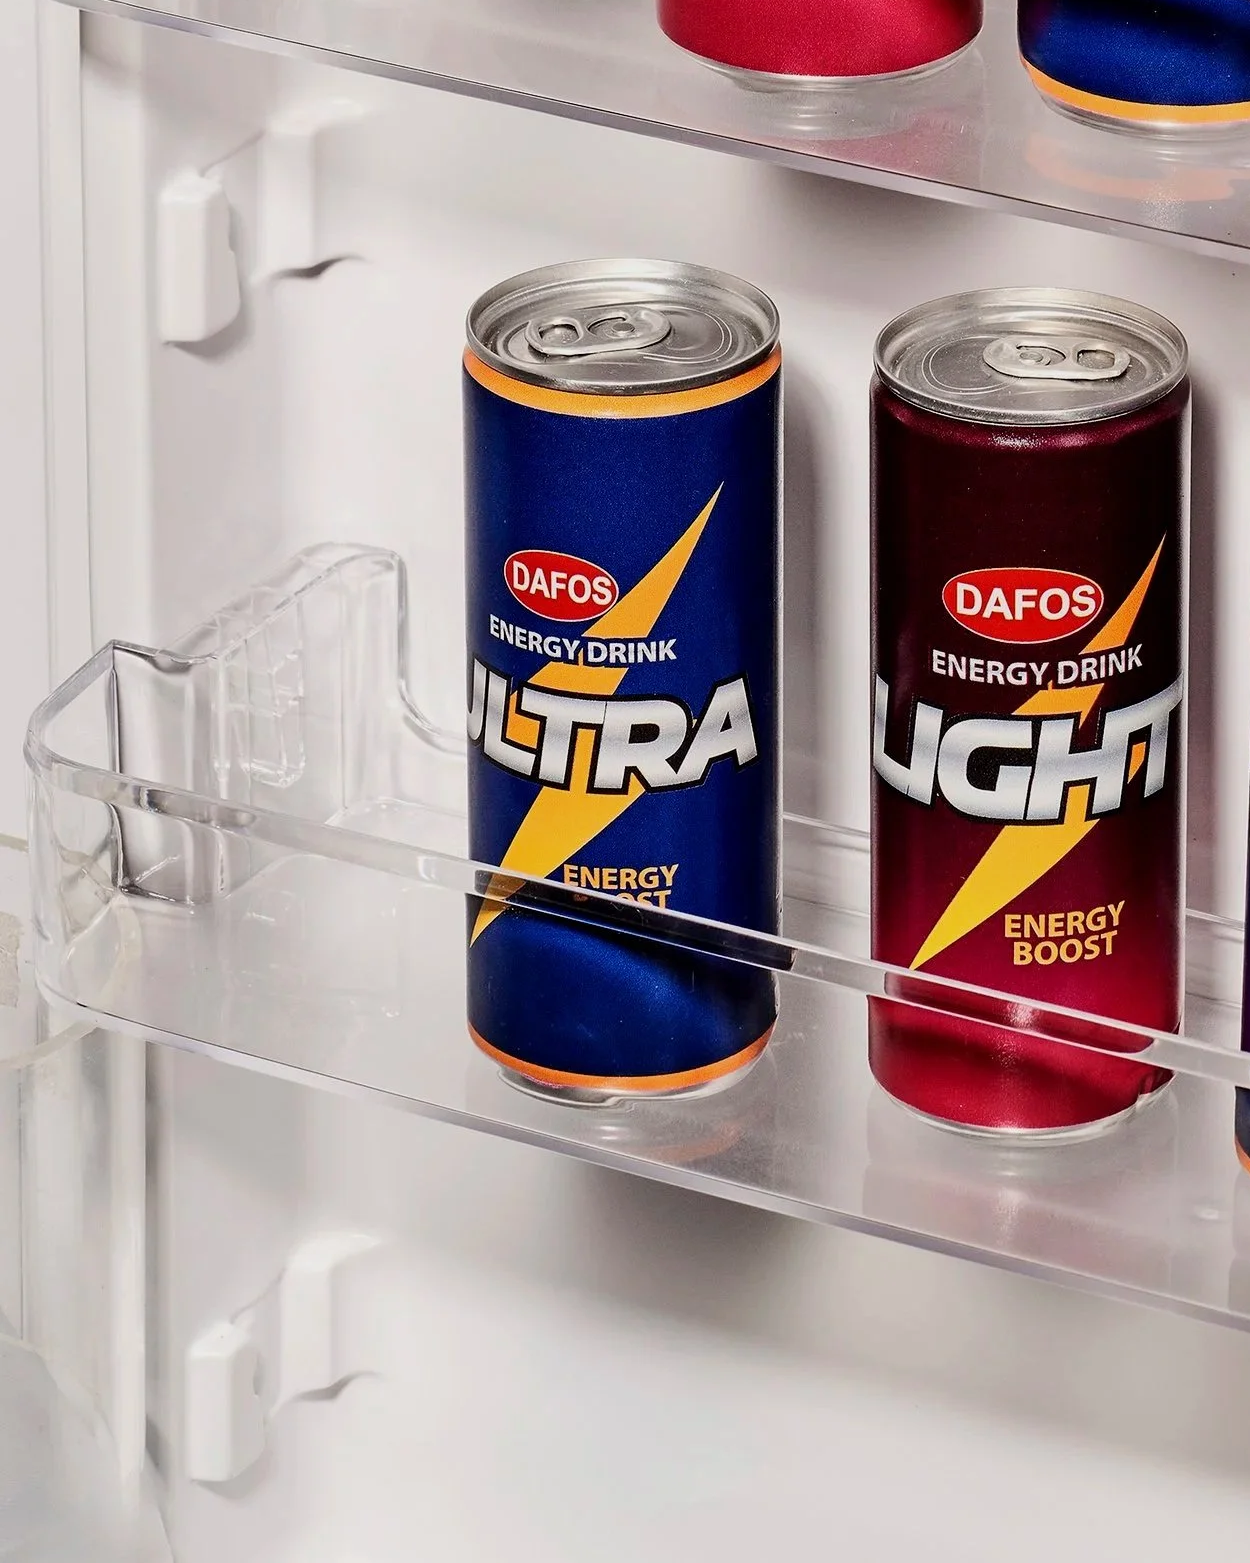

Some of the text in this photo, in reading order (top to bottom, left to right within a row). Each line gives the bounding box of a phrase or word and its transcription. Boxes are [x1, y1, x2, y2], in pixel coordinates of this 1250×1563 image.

[511, 560, 614, 606] DAFOS
[955, 581, 1097, 622] DAFOS
[489, 613, 678, 664] ENERGY DRINK
[931, 643, 1144, 687] ENERGY DRINK
[872, 672, 1183, 821] LIGHT
[563, 863, 679, 890] ENERGY
[1003, 899, 1126, 939] ENERGY
[1012, 929, 1119, 967] BOOST
